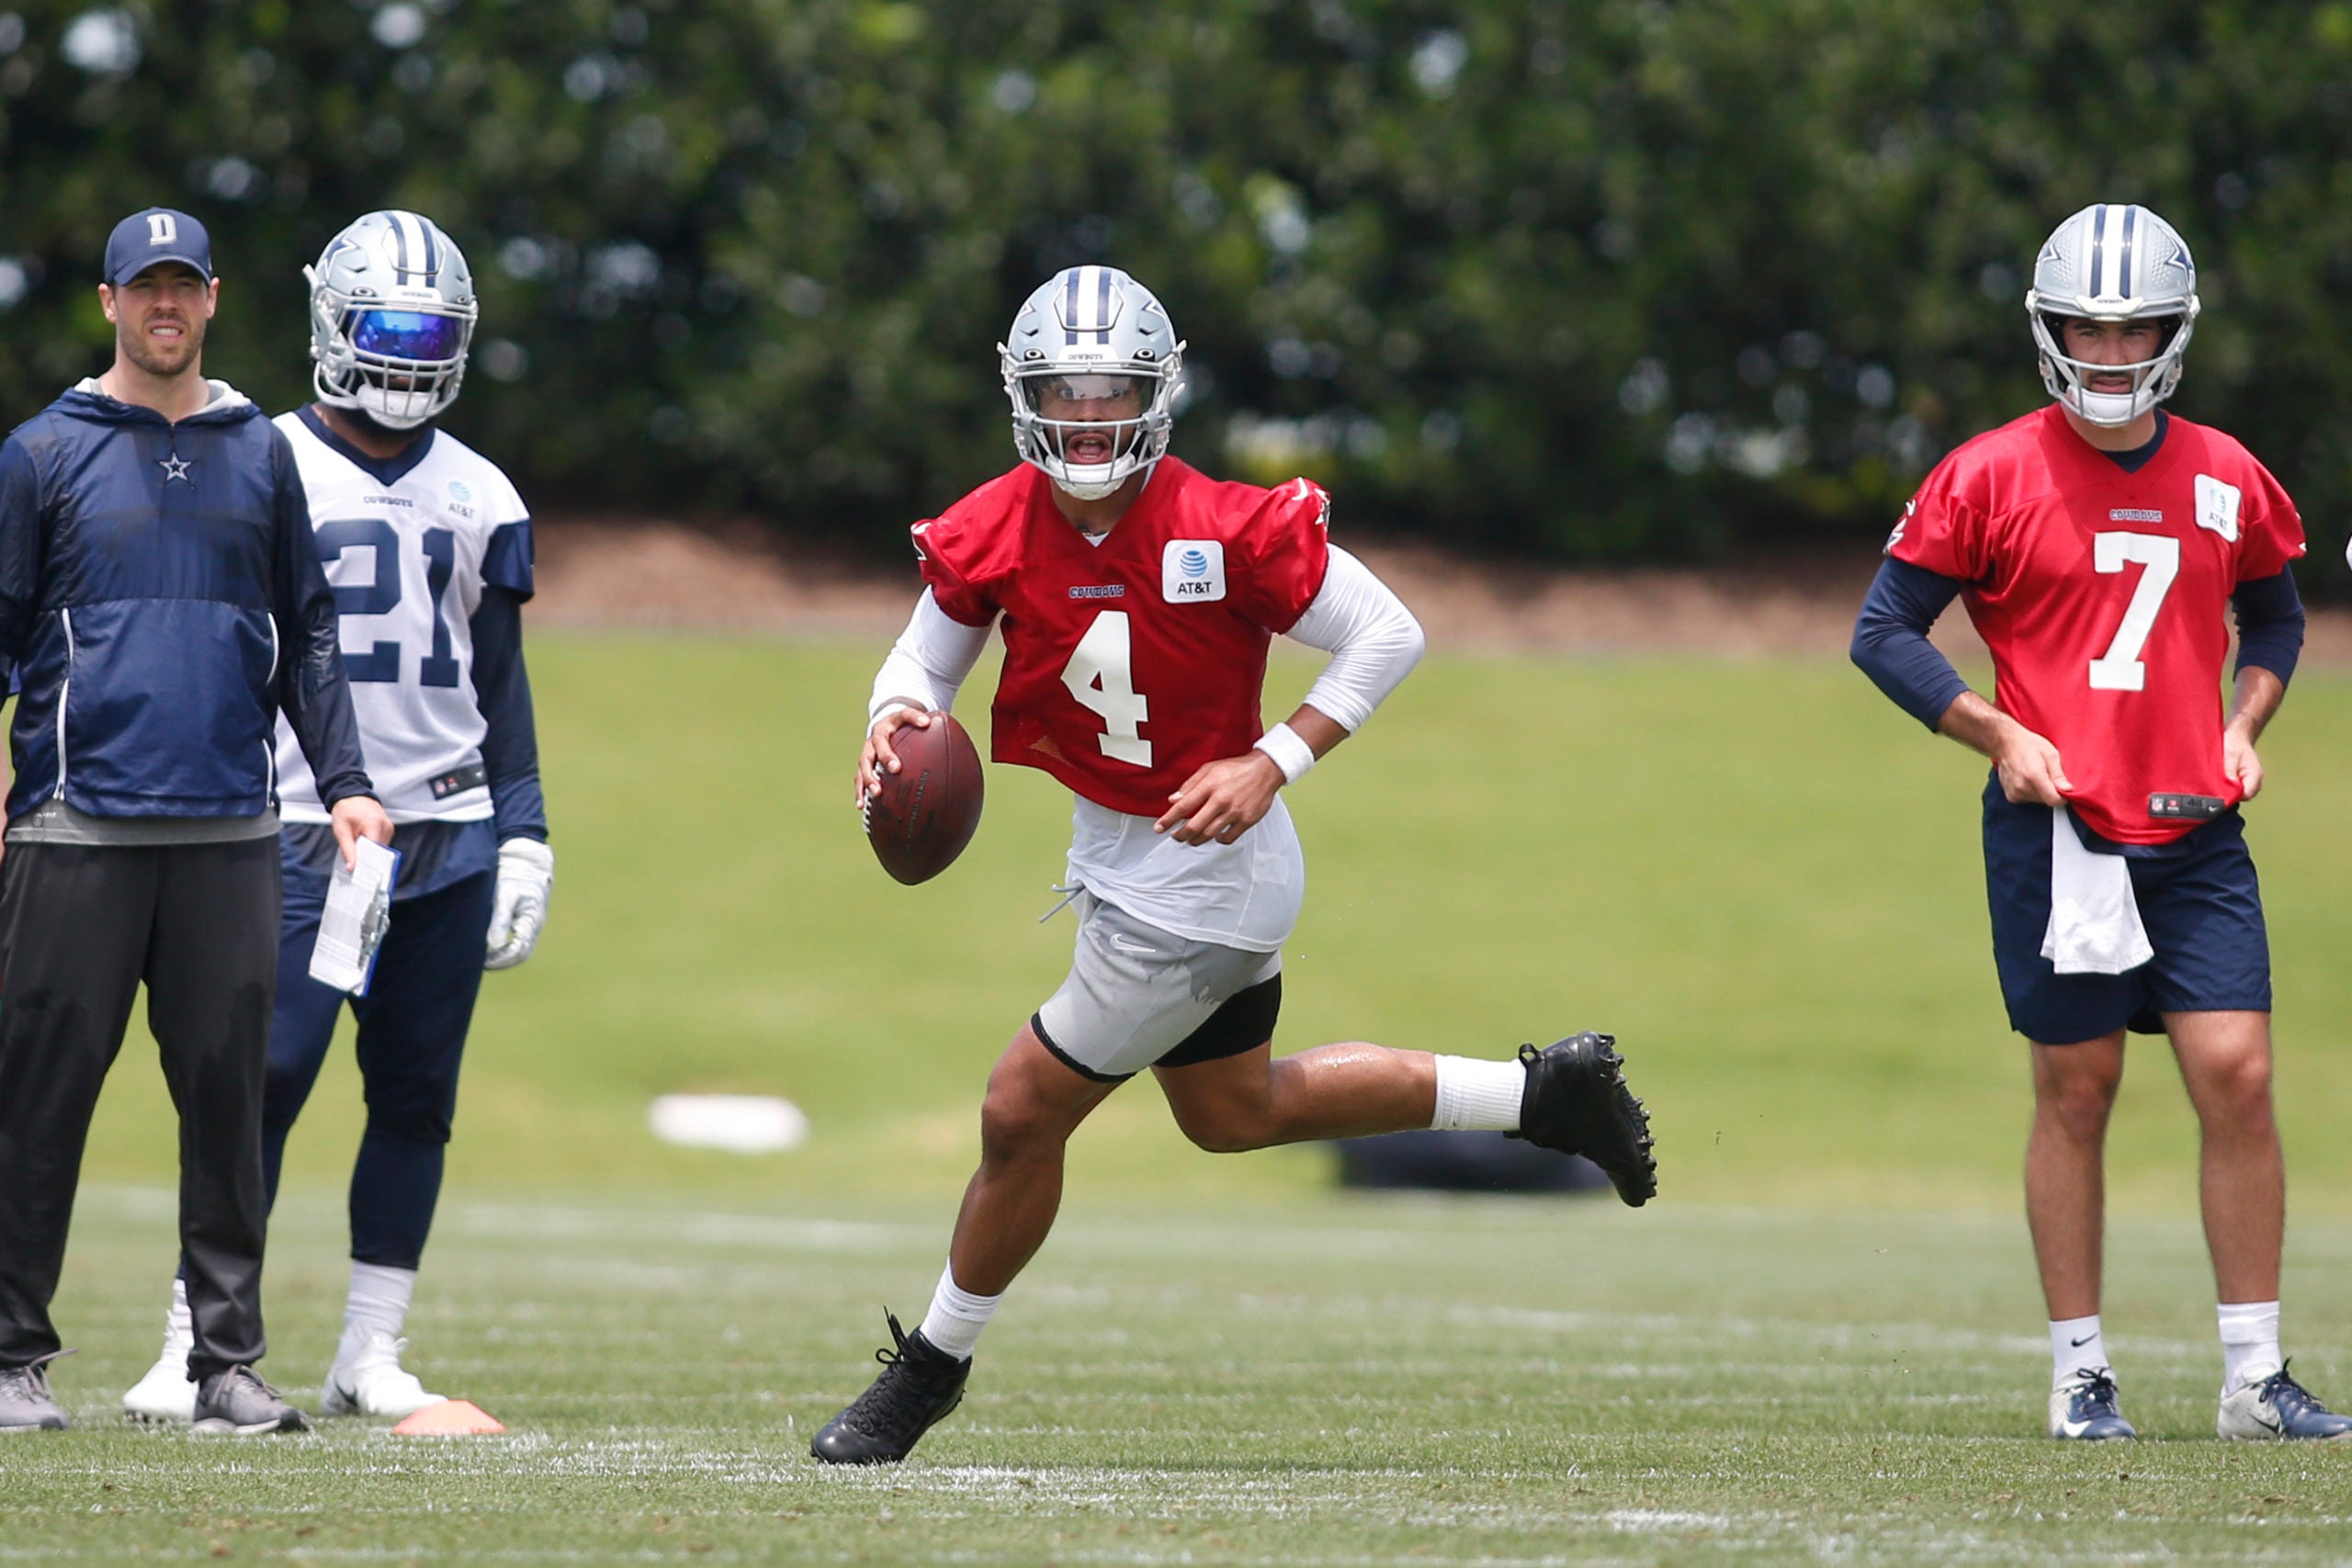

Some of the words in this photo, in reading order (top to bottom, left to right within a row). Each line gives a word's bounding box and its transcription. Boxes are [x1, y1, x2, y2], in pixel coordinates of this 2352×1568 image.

[146, 213, 177, 246] D
[363, 495, 413, 507] COWBOYS
[447, 502, 475, 518] AT&T
[2109, 508, 2163, 524] COWBOYS
[1069, 584, 1125, 599] COWBOYS
[1177, 581, 1213, 594] AT&T
[313, 518, 460, 688] 21
[2088, 531, 2180, 691] 7
[1060, 610, 1153, 768] 4
